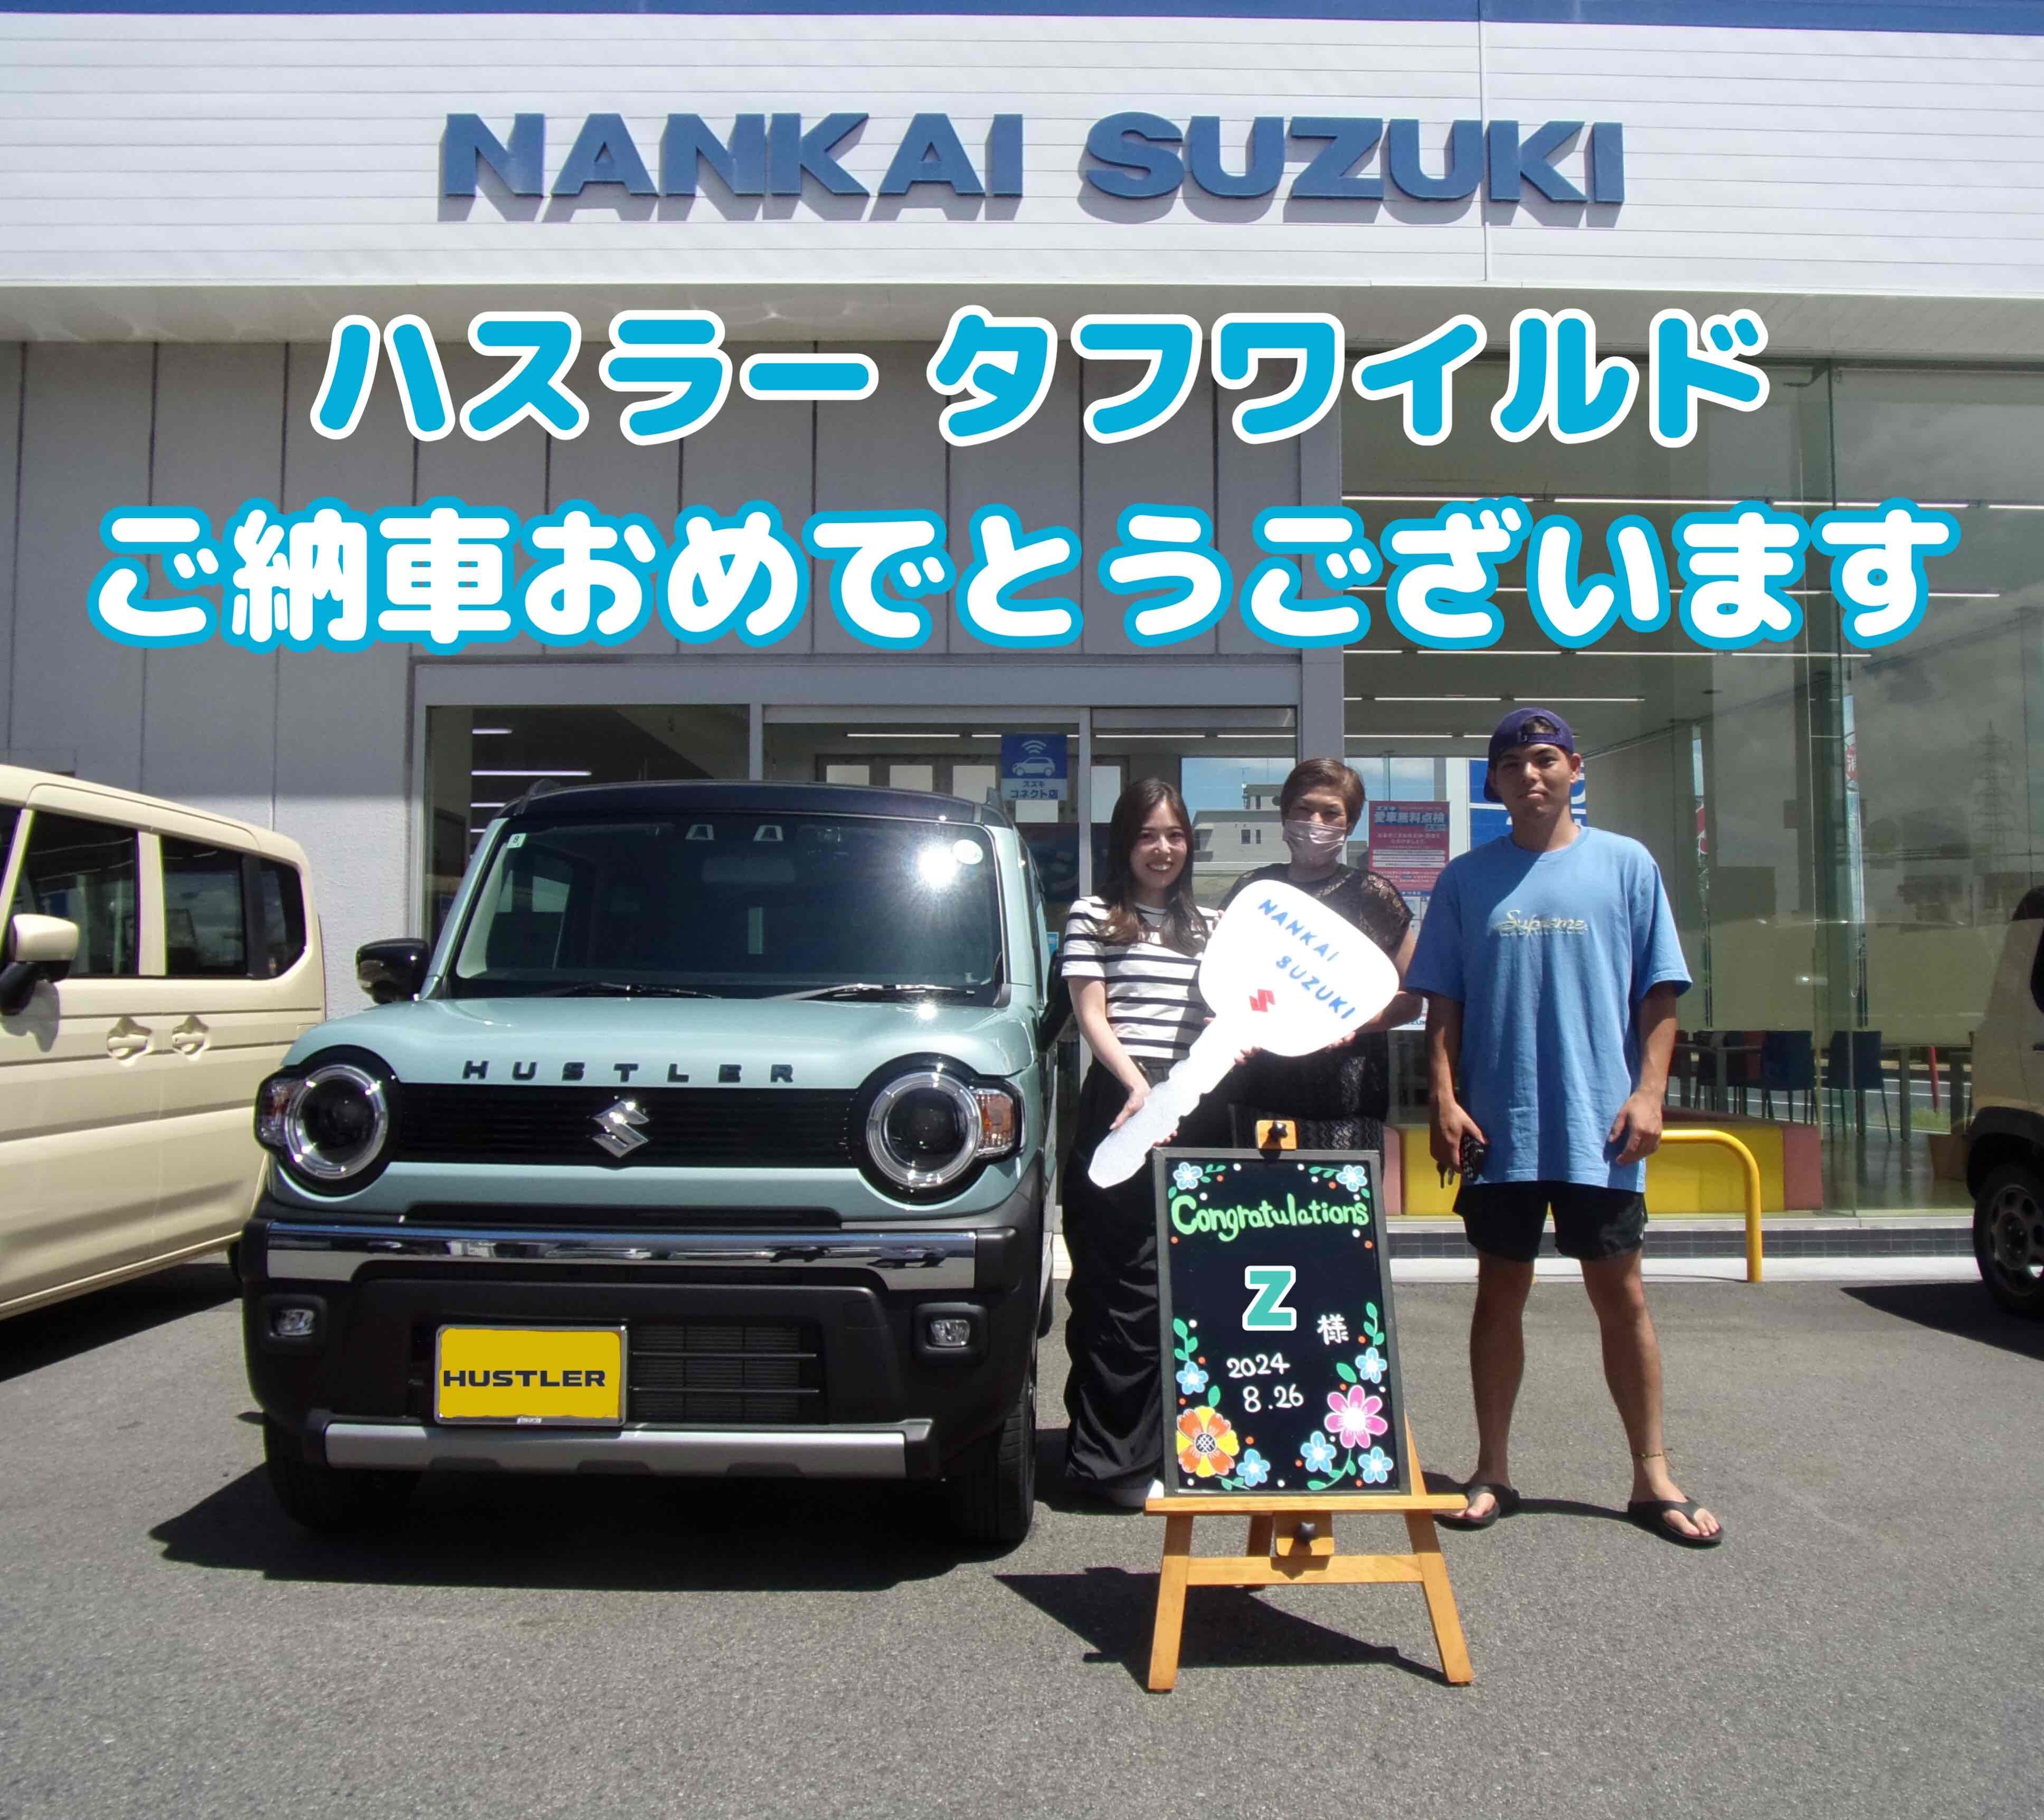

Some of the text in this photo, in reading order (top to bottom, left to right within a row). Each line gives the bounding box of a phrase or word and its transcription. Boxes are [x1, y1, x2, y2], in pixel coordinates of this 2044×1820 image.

[443, 111, 1624, 204] NANKAI SUZUKI
[1010, 789, 1059, 799] コネクト店
[1258, 899, 1339, 962] NANKAI
[1275, 955, 1356, 1019] SUZUKI
[461, 1060, 795, 1084] HUSTLER
[1170, 1193, 1370, 1242] Congratulations
[1317, 1313, 1350, 1345] 様
[1226, 1352, 1291, 1378] 2024
